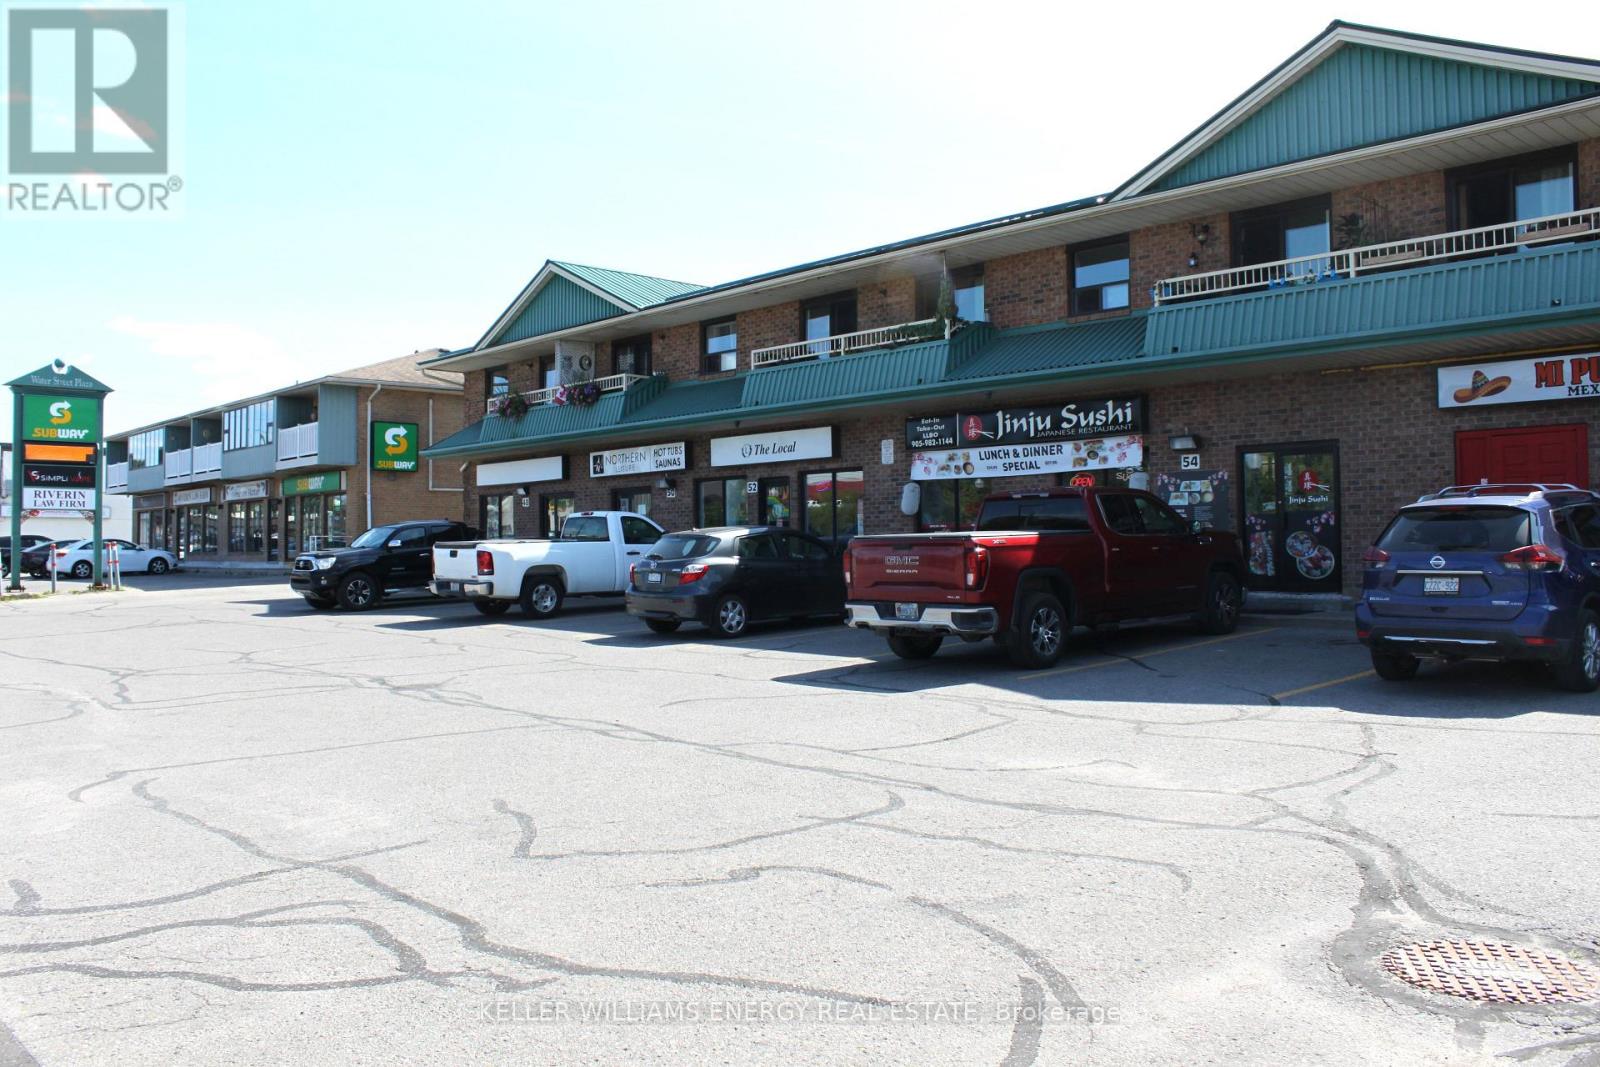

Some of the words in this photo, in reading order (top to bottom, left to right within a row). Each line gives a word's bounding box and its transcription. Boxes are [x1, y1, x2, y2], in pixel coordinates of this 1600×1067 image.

[1534, 359, 1565, 389] MI
[52, 376, 74, 387] Street
[74, 378, 94, 388] Plaza
[995, 410, 1051, 440] Jinju
[1061, 400, 1133, 429] Sushi
[32, 427, 89, 439] SUBWAY
[1037, 428, 1076, 438] JAPANESE
[1078, 423, 1133, 434] RESTAURANT
[653, 447, 667, 457] HOT
[667, 445, 683, 455] TUBS
[753, 444, 769, 456] The
[772, 441, 796, 455] Local
[978, 448, 1010, 461] LUNCH
[1012, 447, 1020, 458] &
[1026, 444, 1064, 457] DINNER
[605, 451, 647, 465] NORTHERN
[655, 458, 681, 469] SAUNAS
[1183, 456, 1198, 468] 54
[376, 460, 416, 469] SUBWAY
[1002, 460, 1041, 472] SPECIAL
[297, 476, 325, 491] SUBWAY
[748, 482, 757, 491] 52
[1072, 477, 1093, 487] OPEN
[33, 490, 86, 499] RIVERIN
[1289, 496, 1306, 504] Jinju
[1307, 495, 1329, 503] Sushi
[33, 500, 55, 508] LAW
[59, 500, 86, 508] FIRM
[885, 555, 919, 566] GMC
